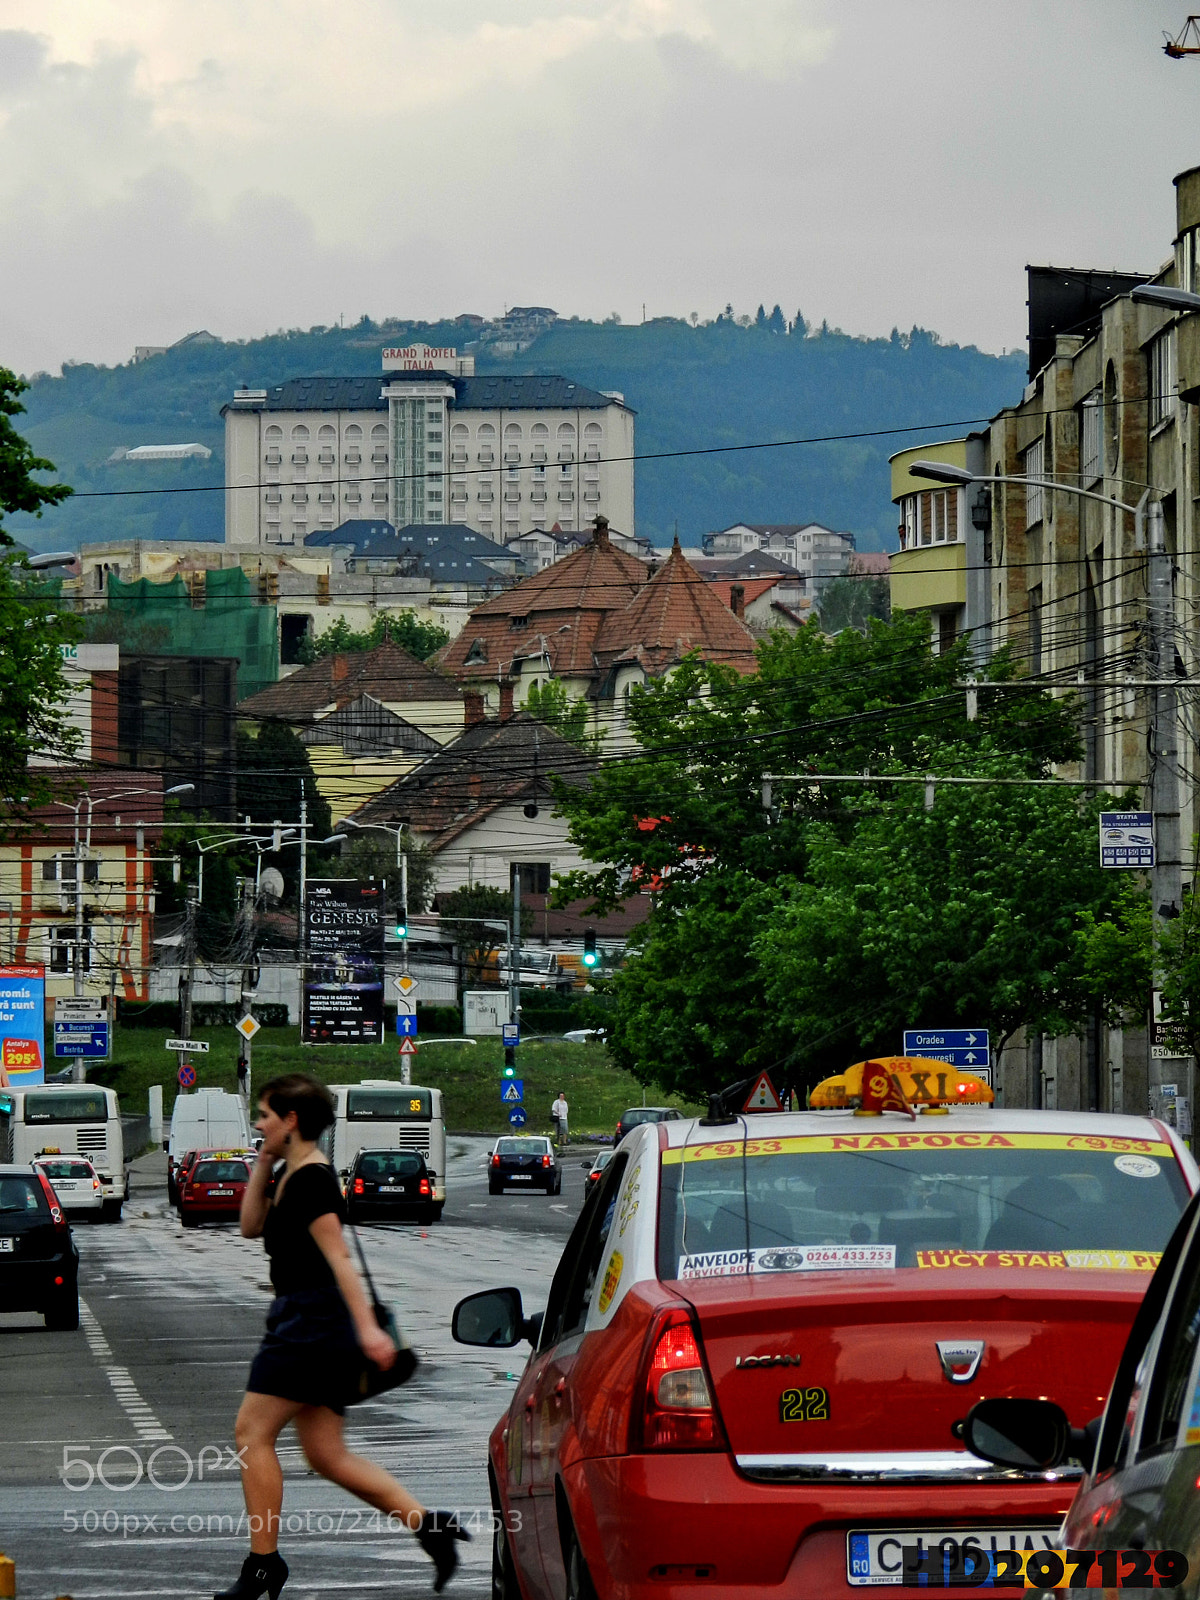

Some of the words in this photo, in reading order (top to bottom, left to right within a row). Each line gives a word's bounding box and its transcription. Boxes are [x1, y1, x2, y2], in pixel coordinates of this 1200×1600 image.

[382, 348, 417, 358] GRAND
[423, 348, 455, 358] HOTEL
[403, 359, 434, 370] ITALIA
[325, 900, 348, 908] Wilson
[310, 912, 378, 925] GENESIS
[0, 988, 31, 998] romis
[12, 1001, 35, 1010] sunt
[916, 1035, 945, 1045] Oradea
[1153, 1048, 1168, 1057] 250
[890, 1062, 912, 1073] 953
[410, 1099, 422, 1111] 35
[831, 1134, 1015, 1150] NAPOCA
[1085, 1137, 1152, 1152] 953
[714, 1140, 782, 1157] 953
[683, 1251, 755, 1270] ANVELOPE
[807, 1251, 892, 1262] 0264.433.253
[917, 1254, 988, 1268] LUCY
[998, 1254, 1065, 1268] STAR
[683, 1267, 724, 1279] SERVICE
[736, 1354, 801, 1370] LOGAN
[782, 1387, 828, 1422] 22
[853, 1561, 869, 1574] RO
